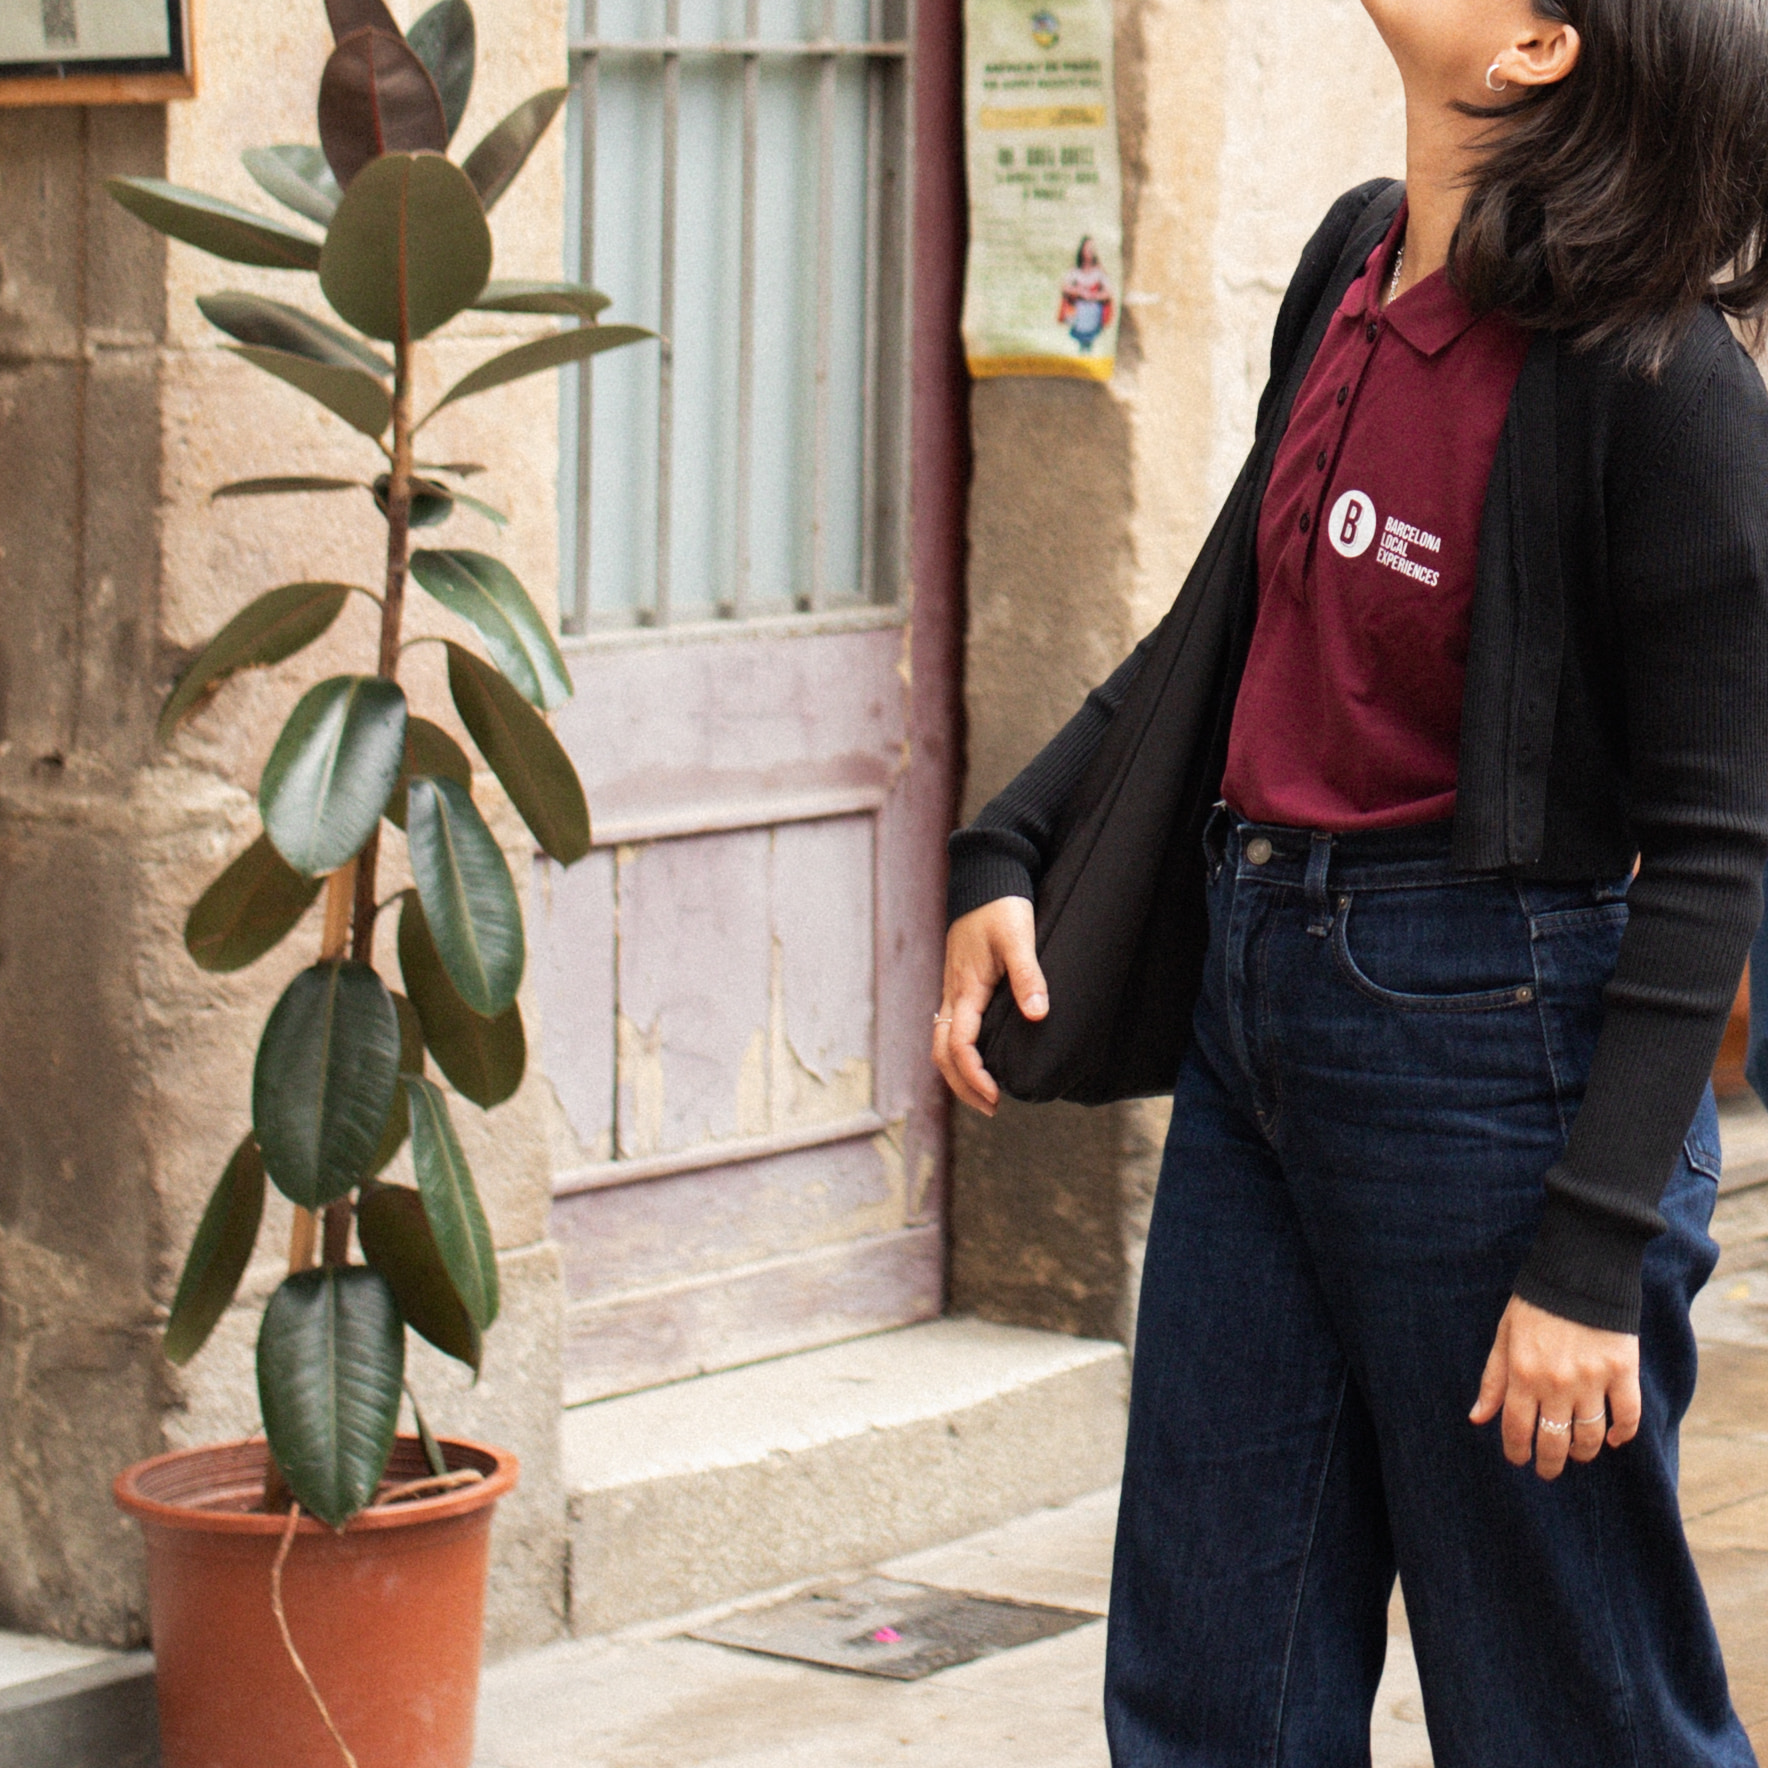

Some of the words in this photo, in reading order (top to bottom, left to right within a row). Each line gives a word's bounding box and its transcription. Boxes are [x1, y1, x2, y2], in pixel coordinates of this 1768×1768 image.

[1380, 532, 1408, 558] LOCAL
[1384, 516, 1442, 553] BARCELONA
[1376, 547, 1440, 587] EXPERIENCES
